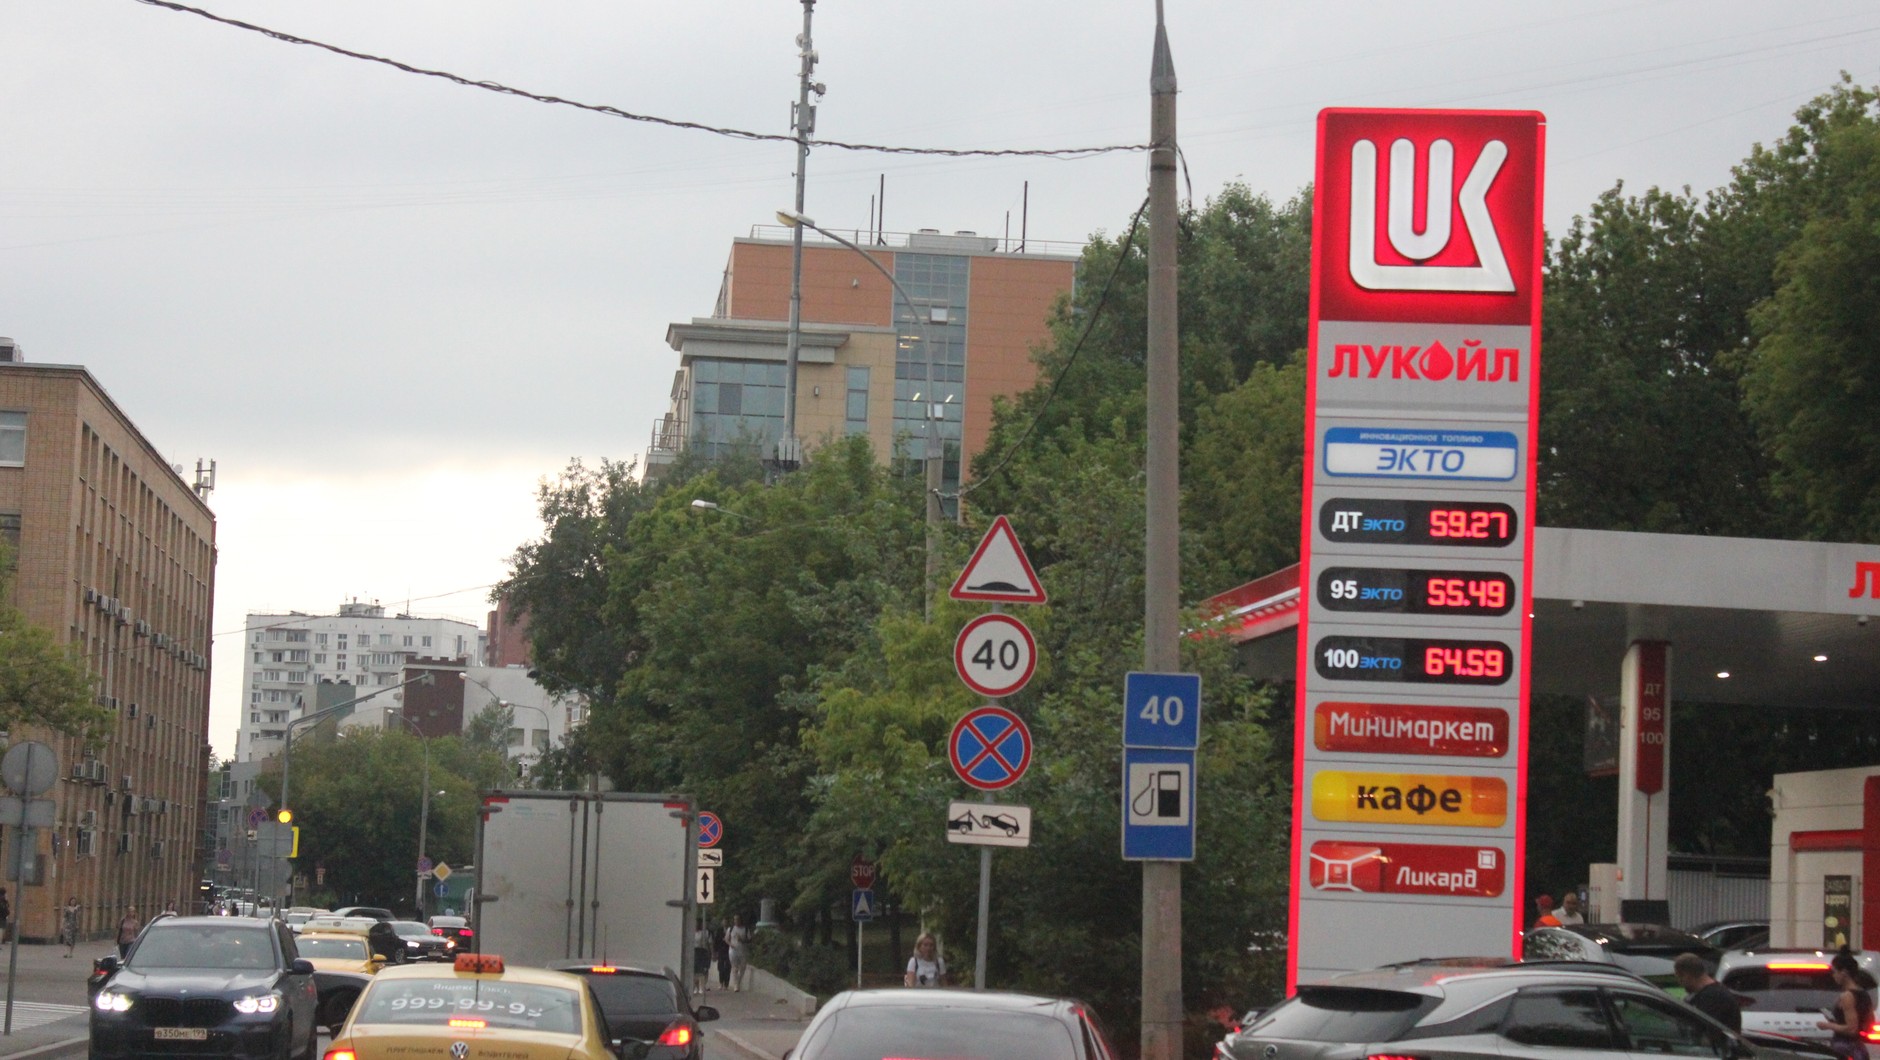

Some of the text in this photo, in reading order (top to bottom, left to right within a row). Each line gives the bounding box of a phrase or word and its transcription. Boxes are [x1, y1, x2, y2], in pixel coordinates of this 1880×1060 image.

[1328, 339, 1520, 383] ЛУКОЙЛ
[1359, 432, 1484, 444] ИННОВАЦИОННОЕ ТОПЛИВО
[1376, 448, 1465, 473] ЭКТО
[1331, 509, 1509, 539] ДТ ЭКТО 59.27
[1330, 579, 1506, 608] 95 ЭКТО 55.49
[971, 639, 1020, 671] 40
[1324, 647, 1504, 677] 100 ЭКТО 64.59
[1643, 683, 1661, 697] ДТ
[1140, 696, 1184, 726] 40
[1642, 707, 1661, 721] 95
[1330, 711, 1495, 748] Минимаркет
[1640, 731, 1664, 745] 100
[1357, 784, 1463, 815] кафе
[852, 864, 875, 878] STOP
[1396, 866, 1477, 892] Ликард
[433, 983, 475, 993] Яндекс
